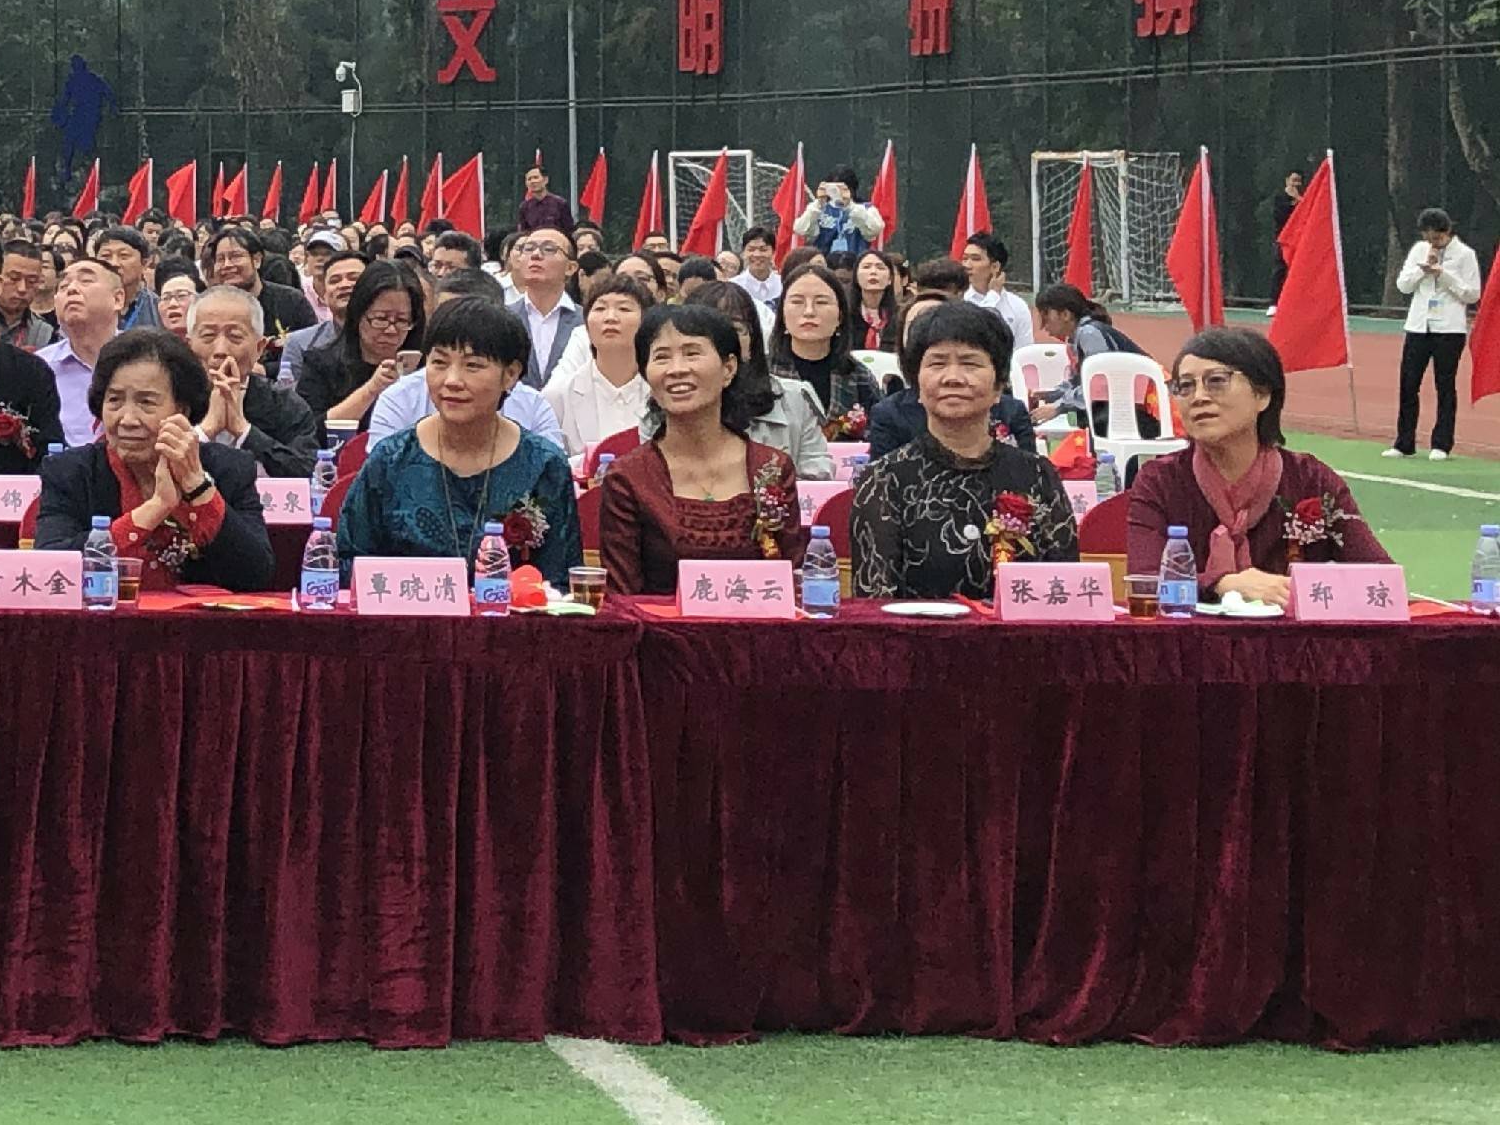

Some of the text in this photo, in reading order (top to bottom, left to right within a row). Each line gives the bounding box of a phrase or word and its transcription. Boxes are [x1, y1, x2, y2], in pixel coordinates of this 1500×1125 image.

[689, 573, 785, 603] 鹿海云
[1010, 576, 1104, 607] 张嘉华
